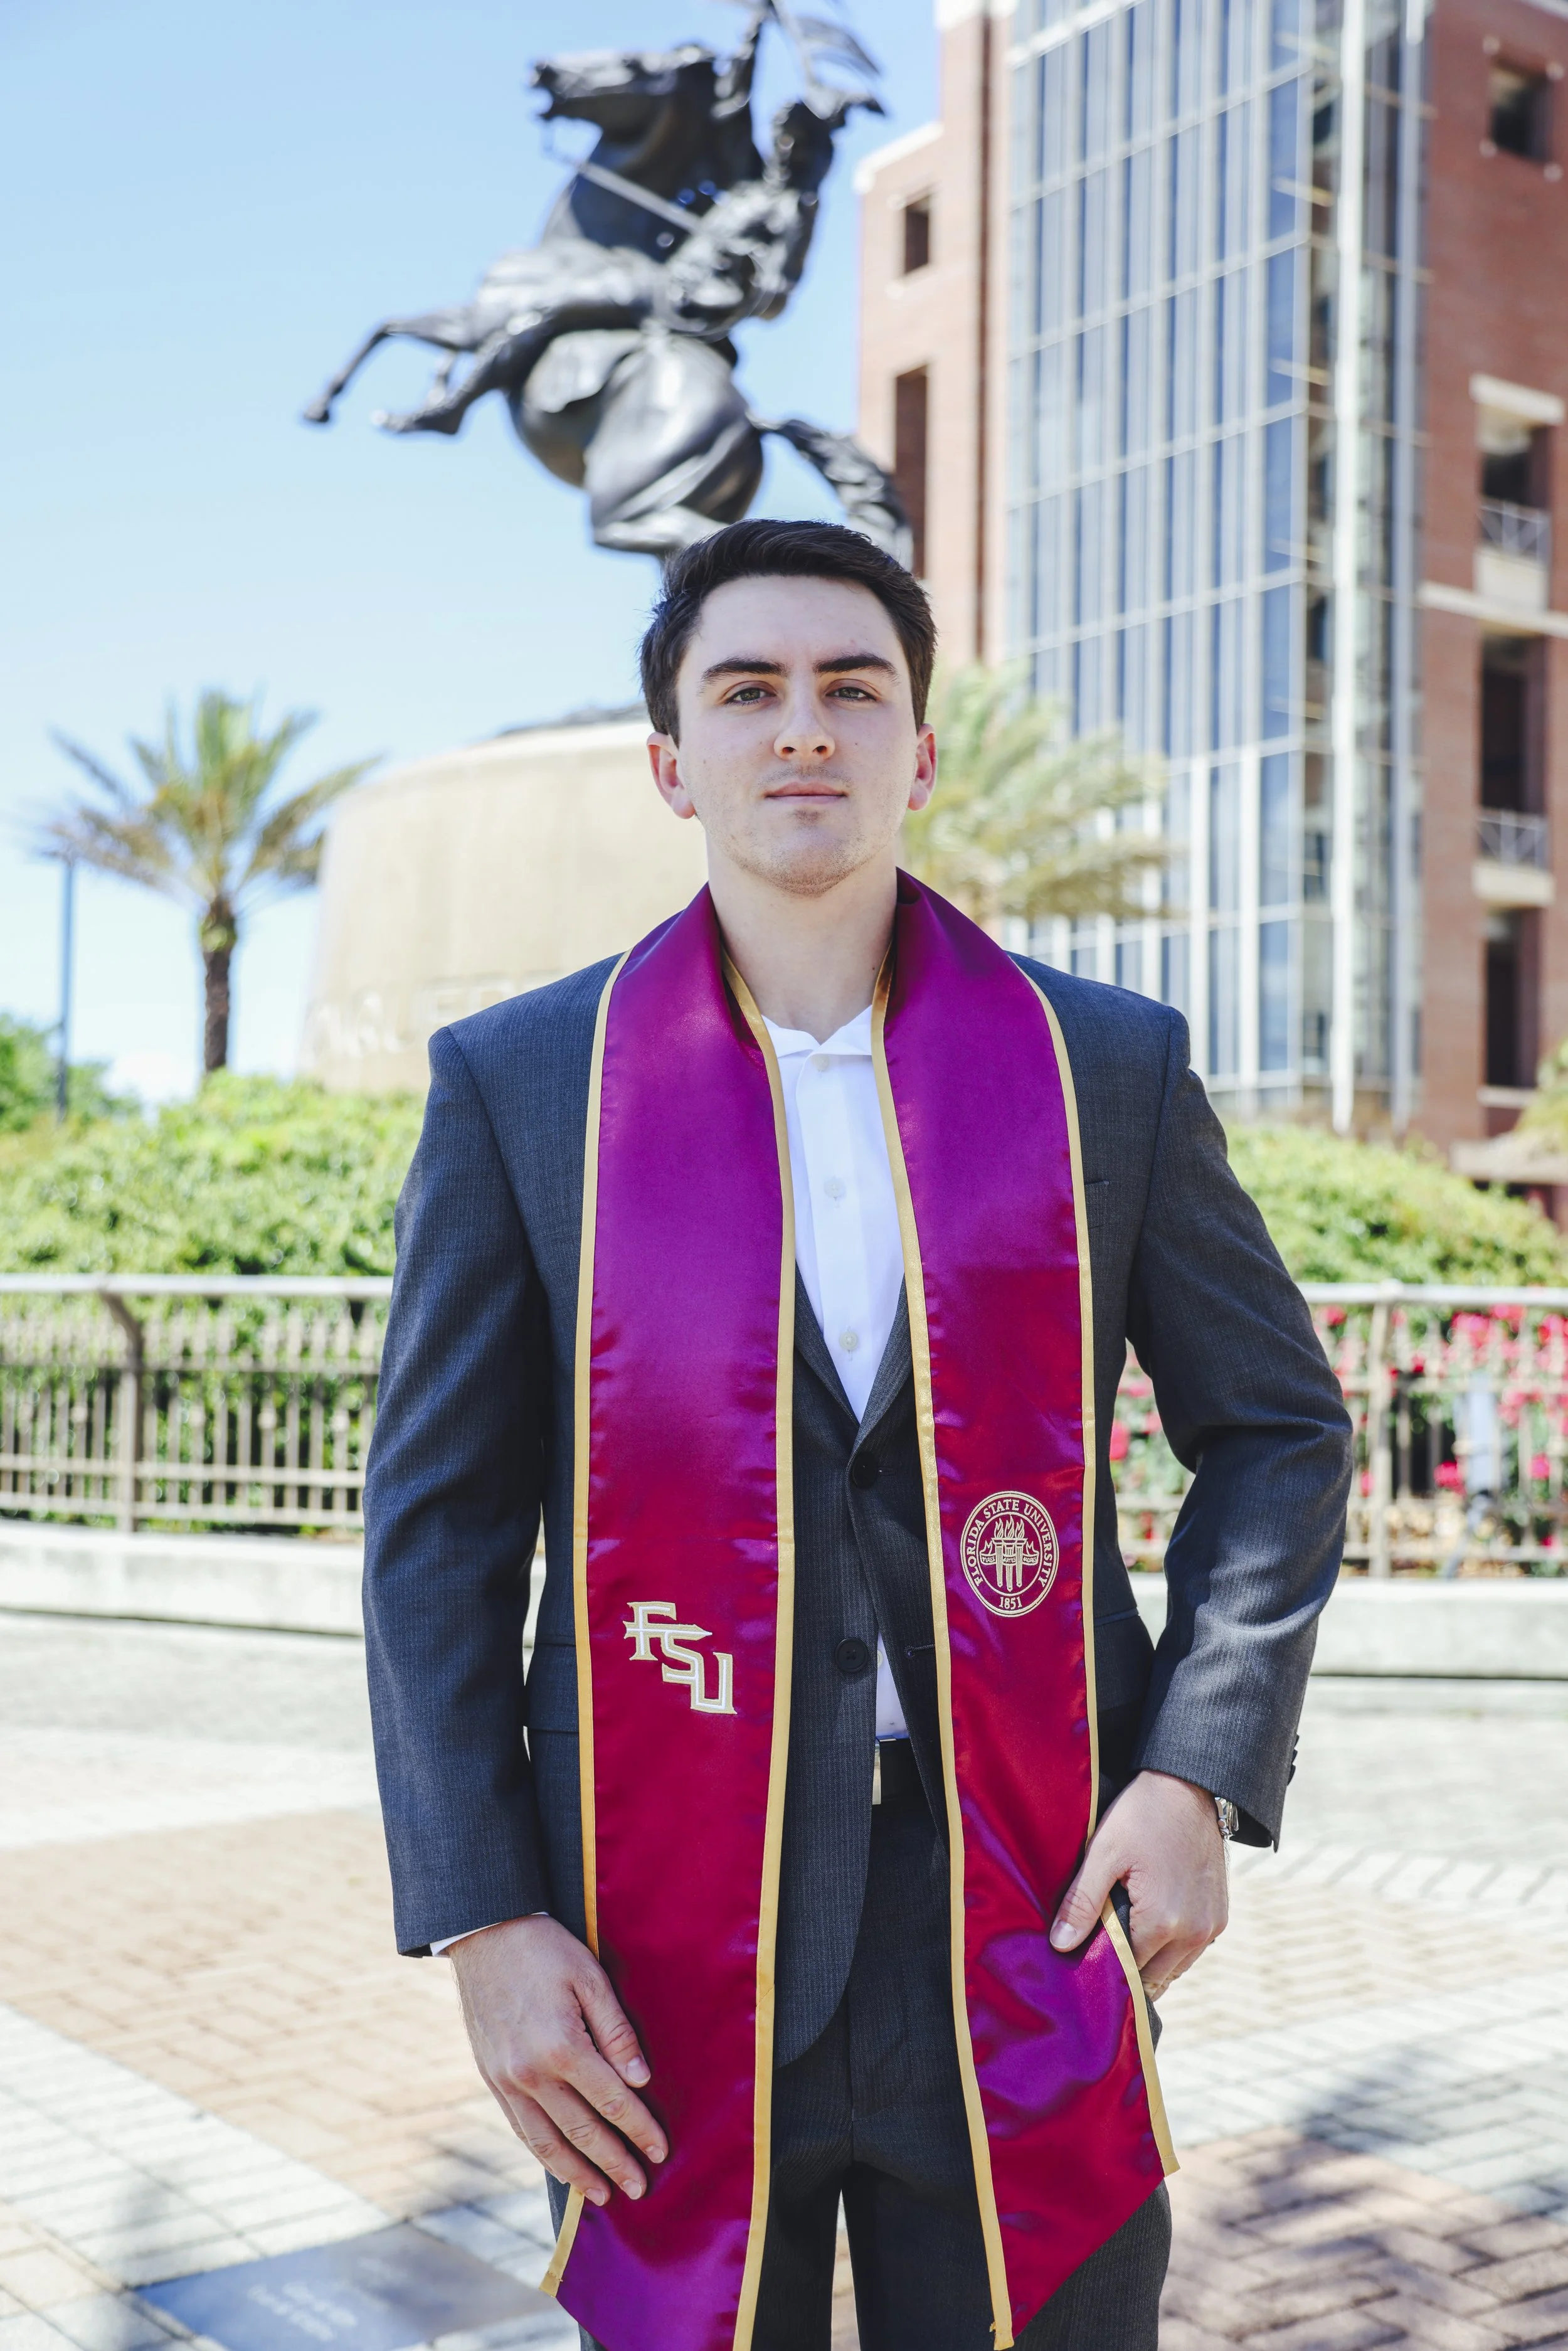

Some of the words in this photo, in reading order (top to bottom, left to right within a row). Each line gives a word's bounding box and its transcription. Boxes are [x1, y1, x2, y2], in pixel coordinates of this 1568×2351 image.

[967, 1519, 985, 1587] FLORIDA
[983, 1499, 1019, 1519] STATE
[1024, 1504, 1053, 1588] UNIVERSITY
[999, 1596, 1022, 1610] 1851
[623, 1601, 738, 1714] FSU
